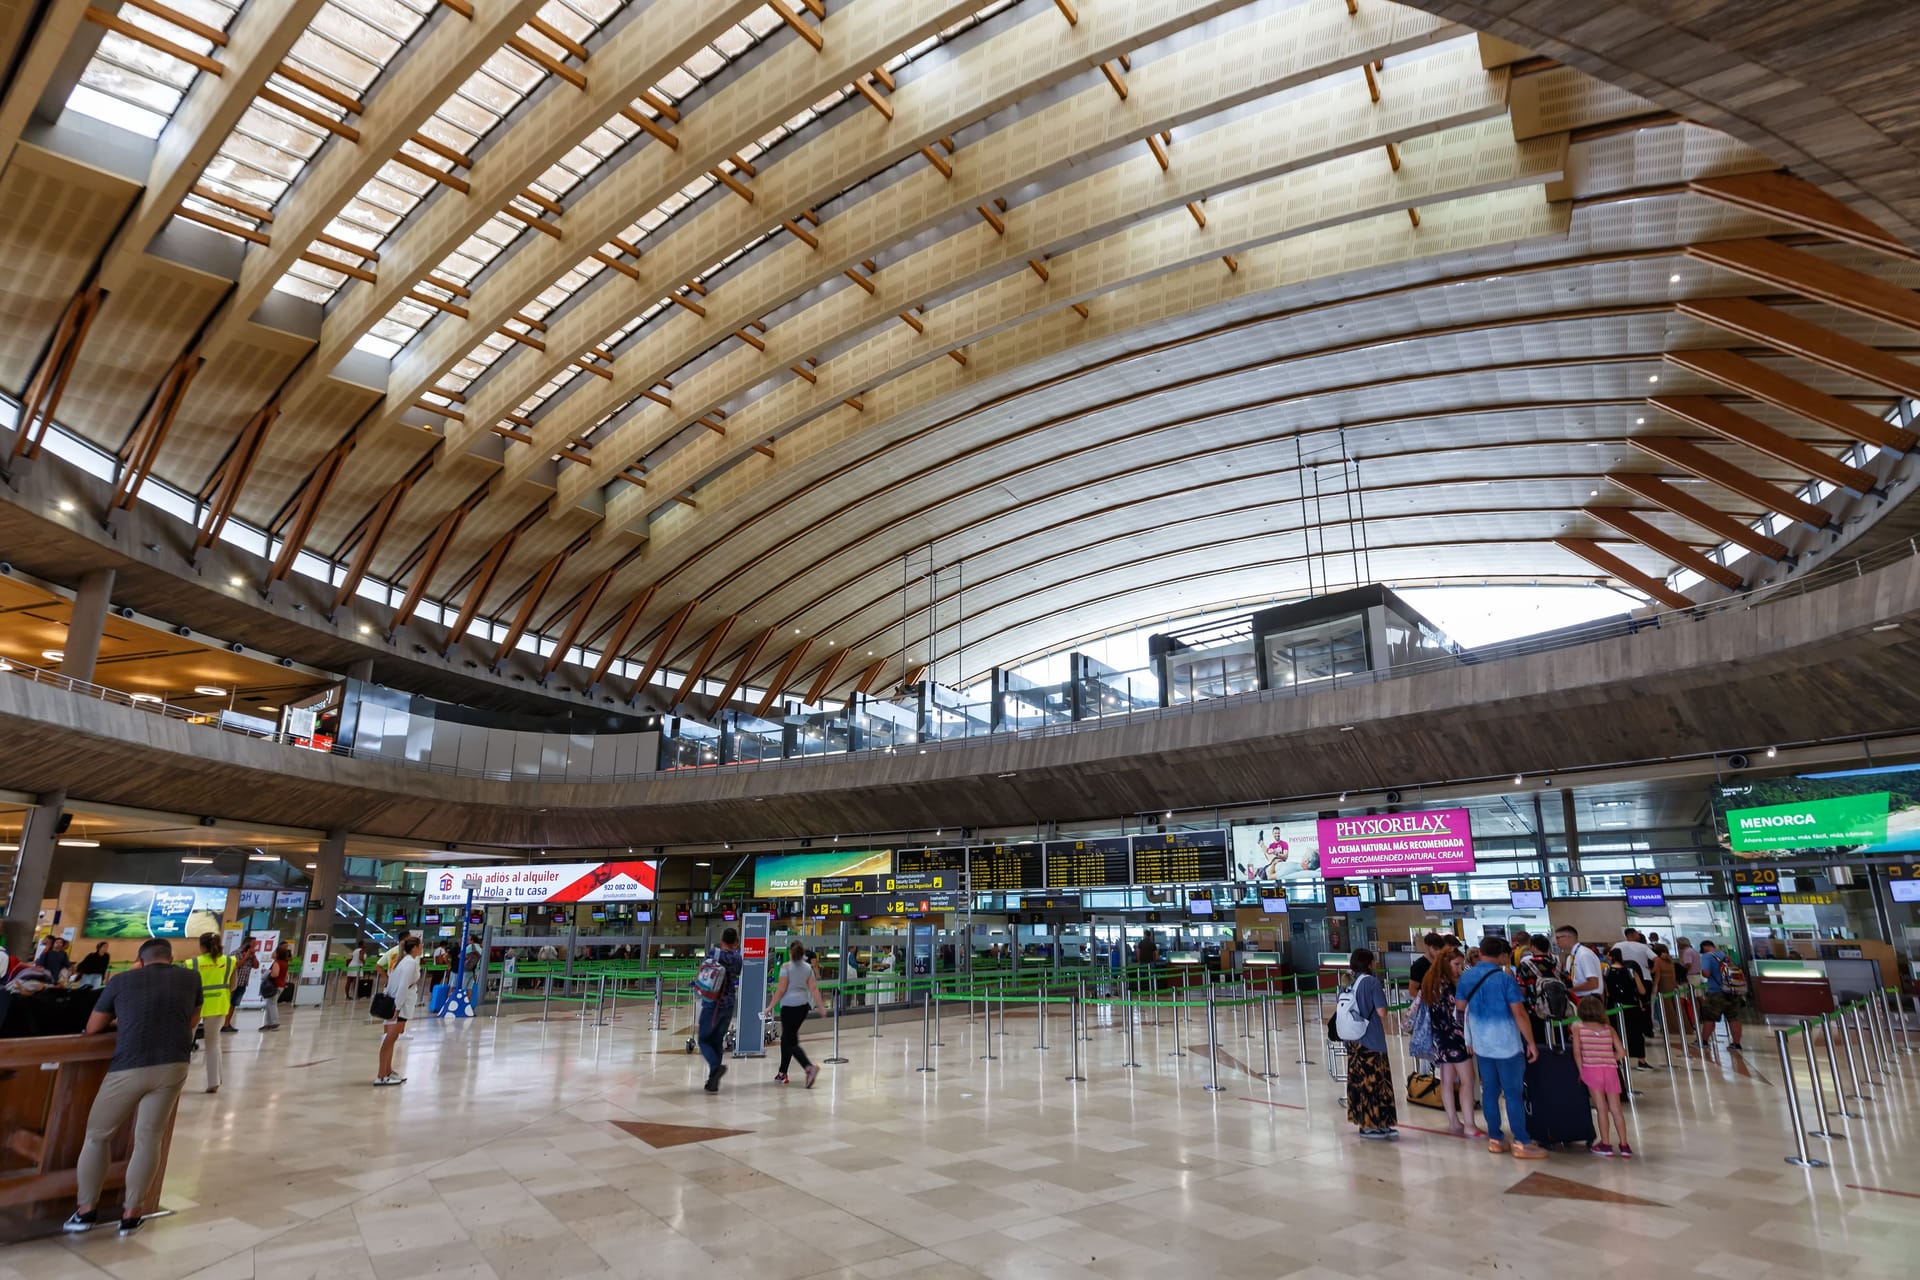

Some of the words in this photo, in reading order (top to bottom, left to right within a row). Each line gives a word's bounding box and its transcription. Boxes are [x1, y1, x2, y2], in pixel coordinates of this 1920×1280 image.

[1336, 815, 1446, 836] PHYSIORELAX
[1740, 814, 1816, 829] MENORCA
[1328, 846, 1337, 854] LA
[1338, 844, 1360, 853] CREMA
[1361, 842, 1392, 852] NATURAL
[1393, 840, 1408, 851] MÁS
[1410, 838, 1464, 849] RECOMENDADA
[1331, 856, 1350, 864] MOST
[1350, 854, 1403, 863] RECOMMENDED
[1404, 852, 1436, 861] NATURAL
[1438, 850, 1463, 859] CREAM
[485, 872, 509, 883] adiós
[512, 872, 520, 882] al
[523, 871, 559, 884] alquiler
[1641, 875, 1659, 886] 19
[1752, 870, 1775, 883] 20
[770, 880, 788, 888] Playa
[1433, 884, 1447, 894] 17
[1524, 880, 1540, 891] 18
[484, 886, 504, 896] Hola
[515, 886, 524, 896] tu
[527, 888, 547, 896] casa
[1200, 890, 1210, 899] 14
[1273, 889, 1285, 898] 15
[1344, 886, 1358, 896] 16
